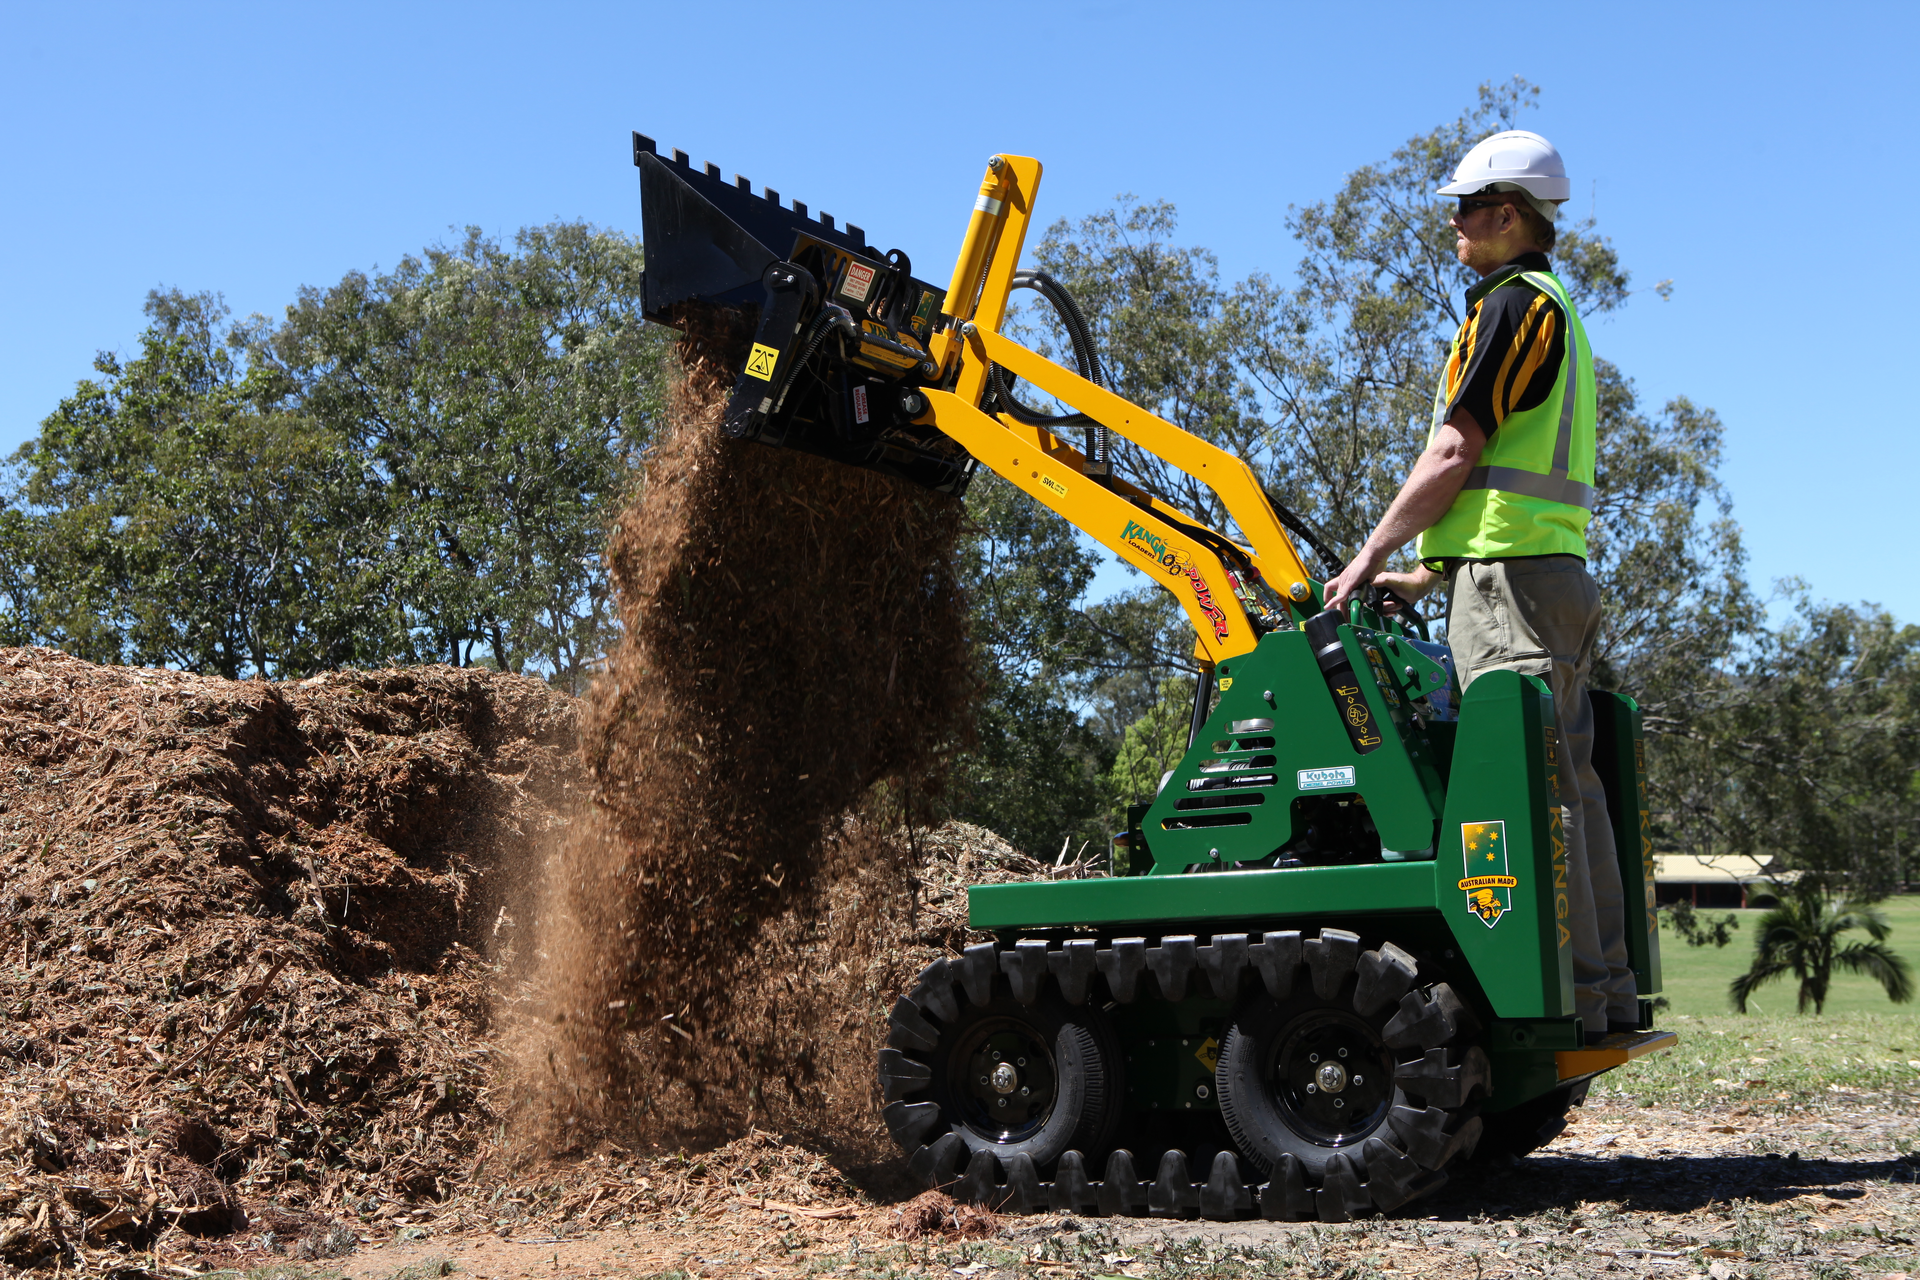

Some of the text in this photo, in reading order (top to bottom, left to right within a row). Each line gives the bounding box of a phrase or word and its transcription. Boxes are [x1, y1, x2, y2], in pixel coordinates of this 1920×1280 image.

[850, 266, 871, 282] DANGER
[854, 388, 863, 422] REGULARLY
[1042, 476, 1055, 490] SWL
[1119, 519, 1168, 563] KANGA
[1128, 539, 1155, 559] LOADERS
[1184, 567, 1229, 646] POWER
[1306, 770, 1346, 781] Kubota
[1460, 877, 1515, 888] AUSTRALIAN MADE
[1549, 806, 1571, 949] KANGA
[1639, 809, 1658, 935] KANGA
